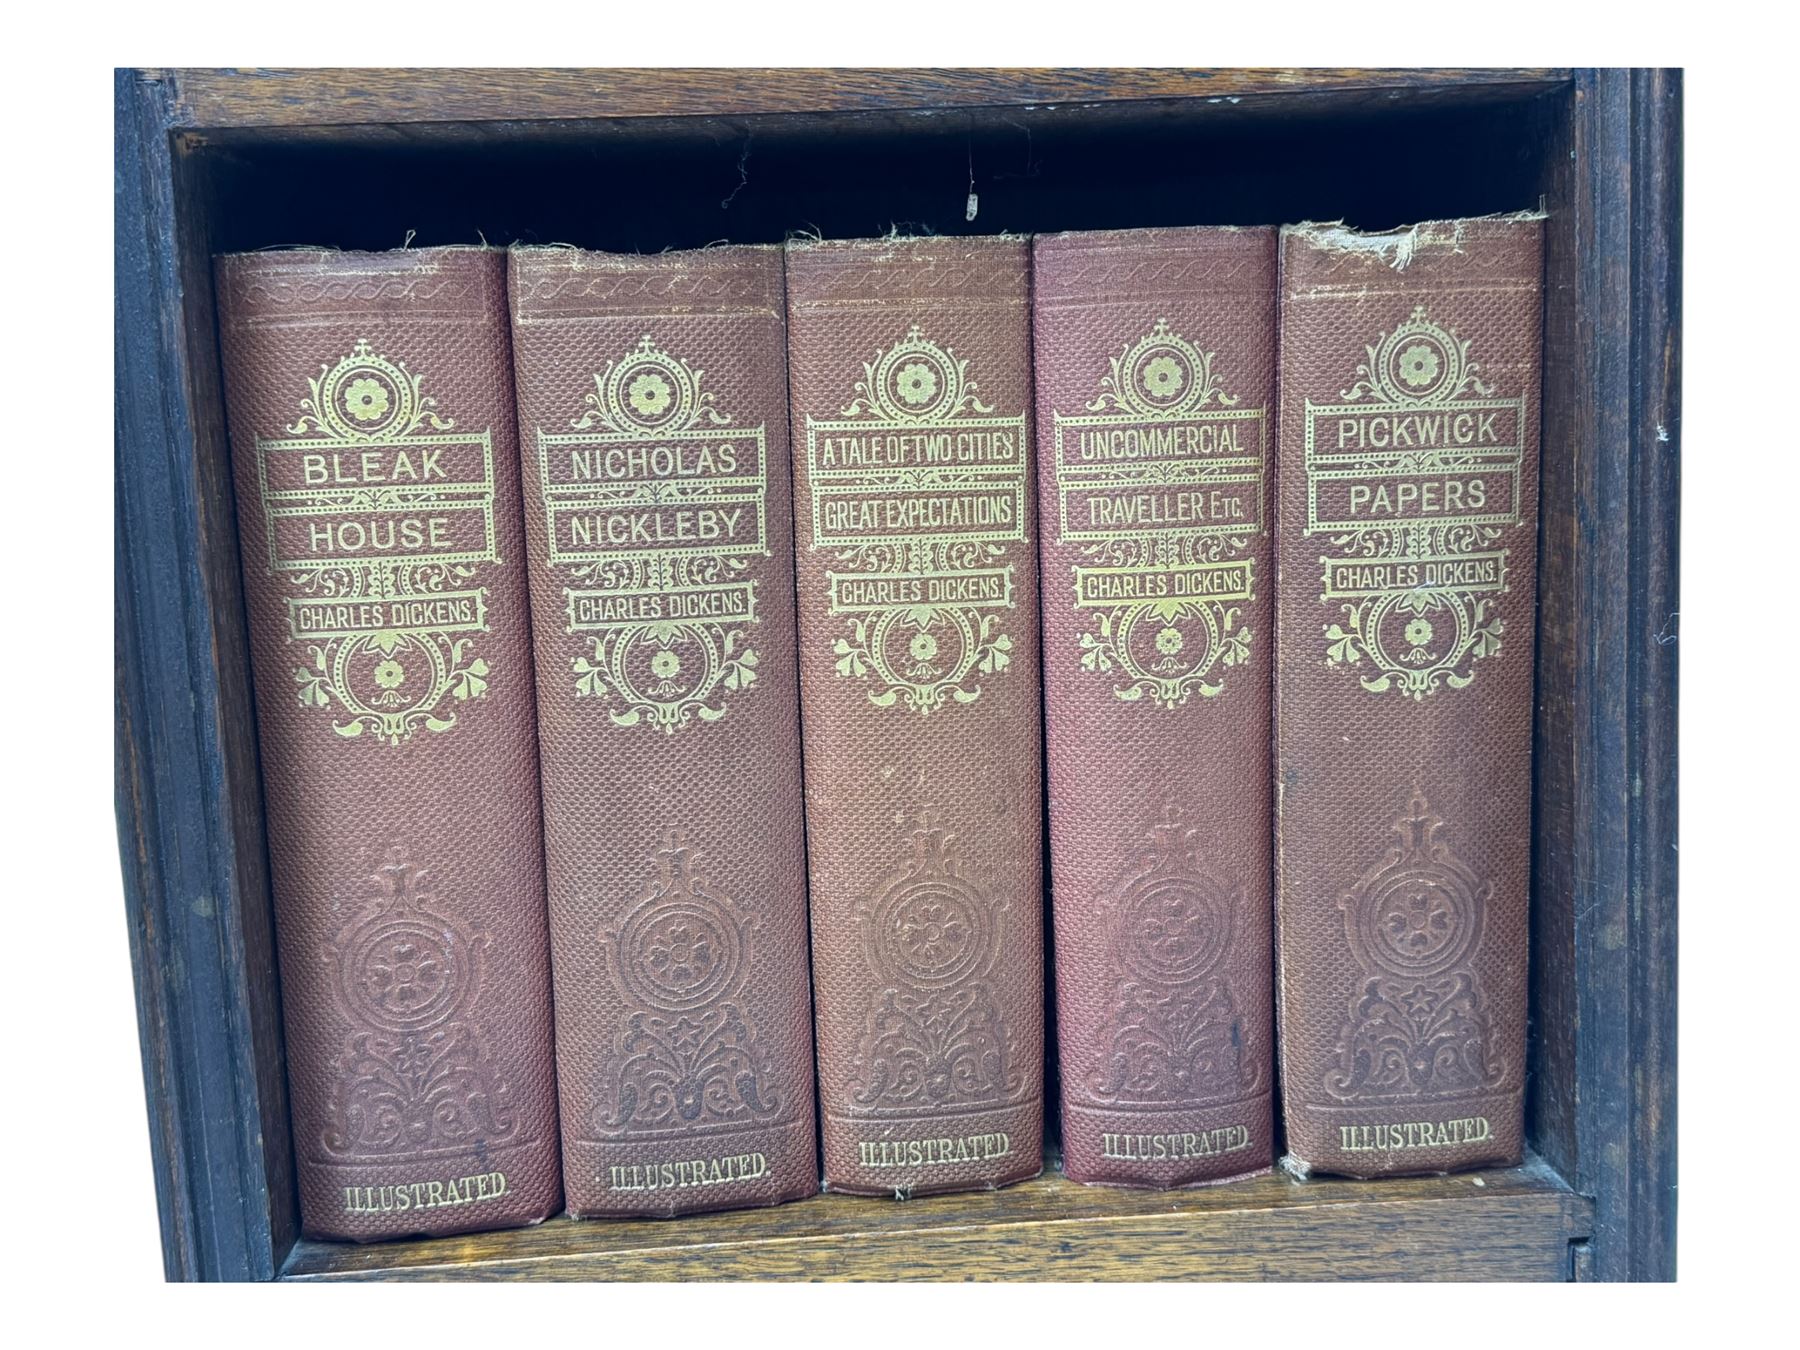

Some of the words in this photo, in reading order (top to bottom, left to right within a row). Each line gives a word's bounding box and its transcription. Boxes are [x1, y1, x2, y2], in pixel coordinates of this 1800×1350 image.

[1080, 424, 1244, 460] UNCOMMERCIAL
[1338, 412, 1497, 448] PICKWICK
[571, 444, 737, 479] NICHOLAS
[822, 438, 835, 466] A
[836, 437, 882, 465] TALE
[887, 435, 908, 463] OF
[908, 434, 952, 462] TWO
[957, 432, 1013, 461] CITIES
[303, 450, 447, 484] BLEAK
[825, 500, 880, 530] GREAT
[886, 495, 1011, 528] EXPECTATIONS
[1086, 492, 1203, 525] TRAVELLER
[1350, 479, 1486, 513] PAPERS
[309, 518, 453, 551] HOUSE
[571, 508, 741, 545] NICKLEBY
[842, 580, 921, 604] CHARLES
[928, 577, 1002, 600] DICKENS.
[1087, 574, 1167, 598] CHARLES
[1174, 570, 1244, 594] DICKENS.
[1336, 565, 1418, 589] CHARLES
[1425, 560, 1497, 585] DICKENS.
[300, 605, 384, 630] CHARLES
[392, 601, 475, 626] DICKENS.
[579, 596, 661, 621] CHARLES
[669, 591, 746, 617] DICKENS.
